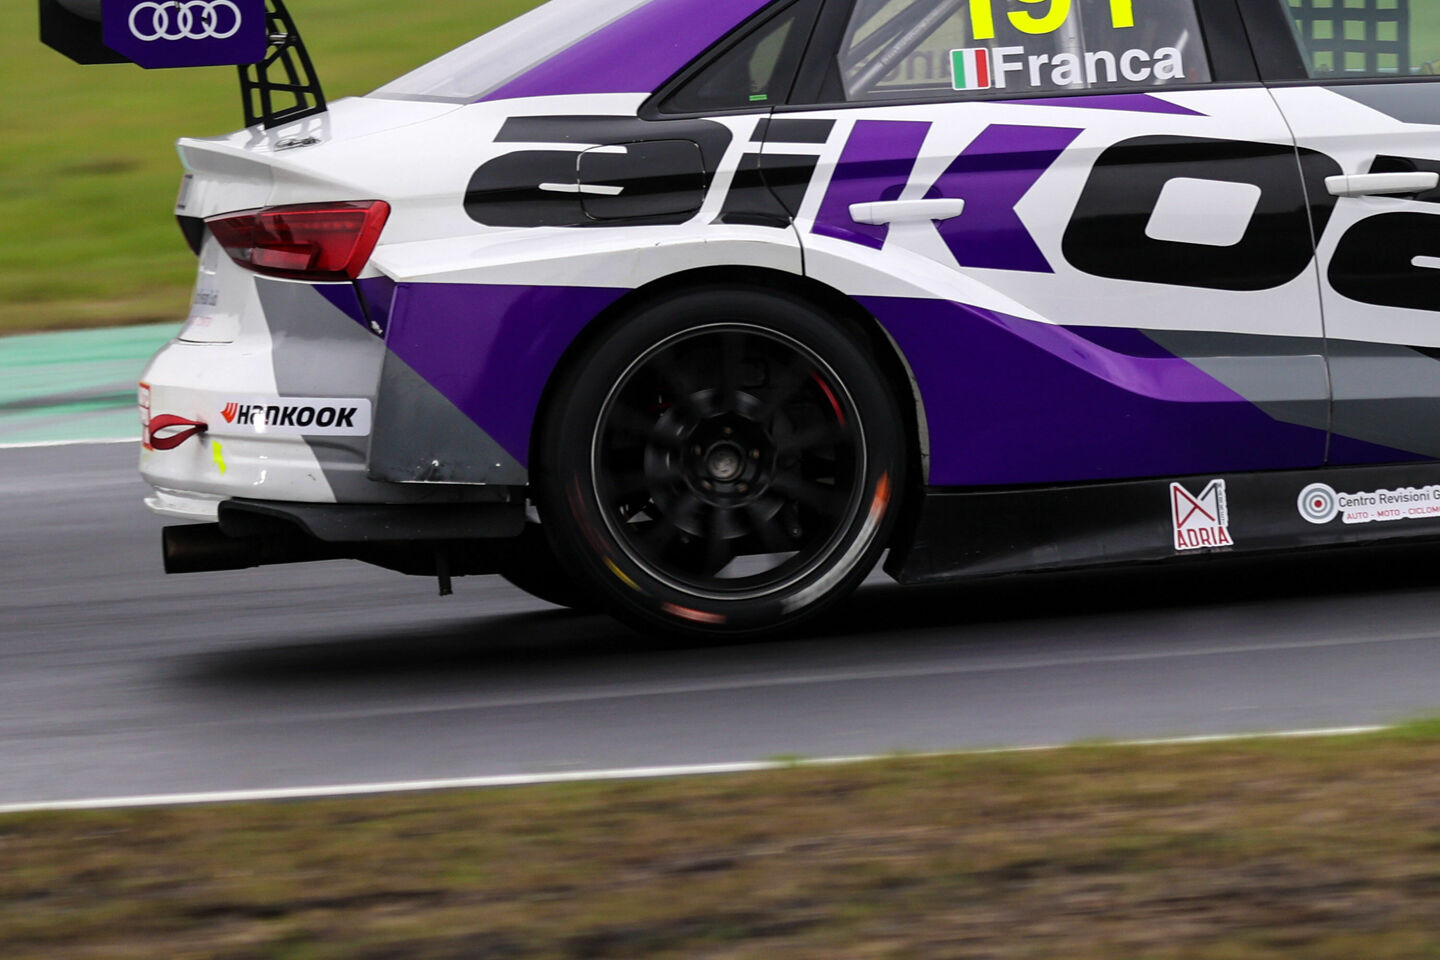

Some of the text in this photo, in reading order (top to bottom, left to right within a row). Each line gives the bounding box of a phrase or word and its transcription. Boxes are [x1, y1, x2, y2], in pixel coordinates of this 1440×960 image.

[992, 43, 1187, 89] Franca
[1339, 497, 1376, 508] Centro
[1379, 490, 1430, 504] Revisioni
[1346, 512, 1369, 520] AUTO
[1377, 509, 1400, 517] MOTO
[1177, 526, 1230, 548] ADRIA
